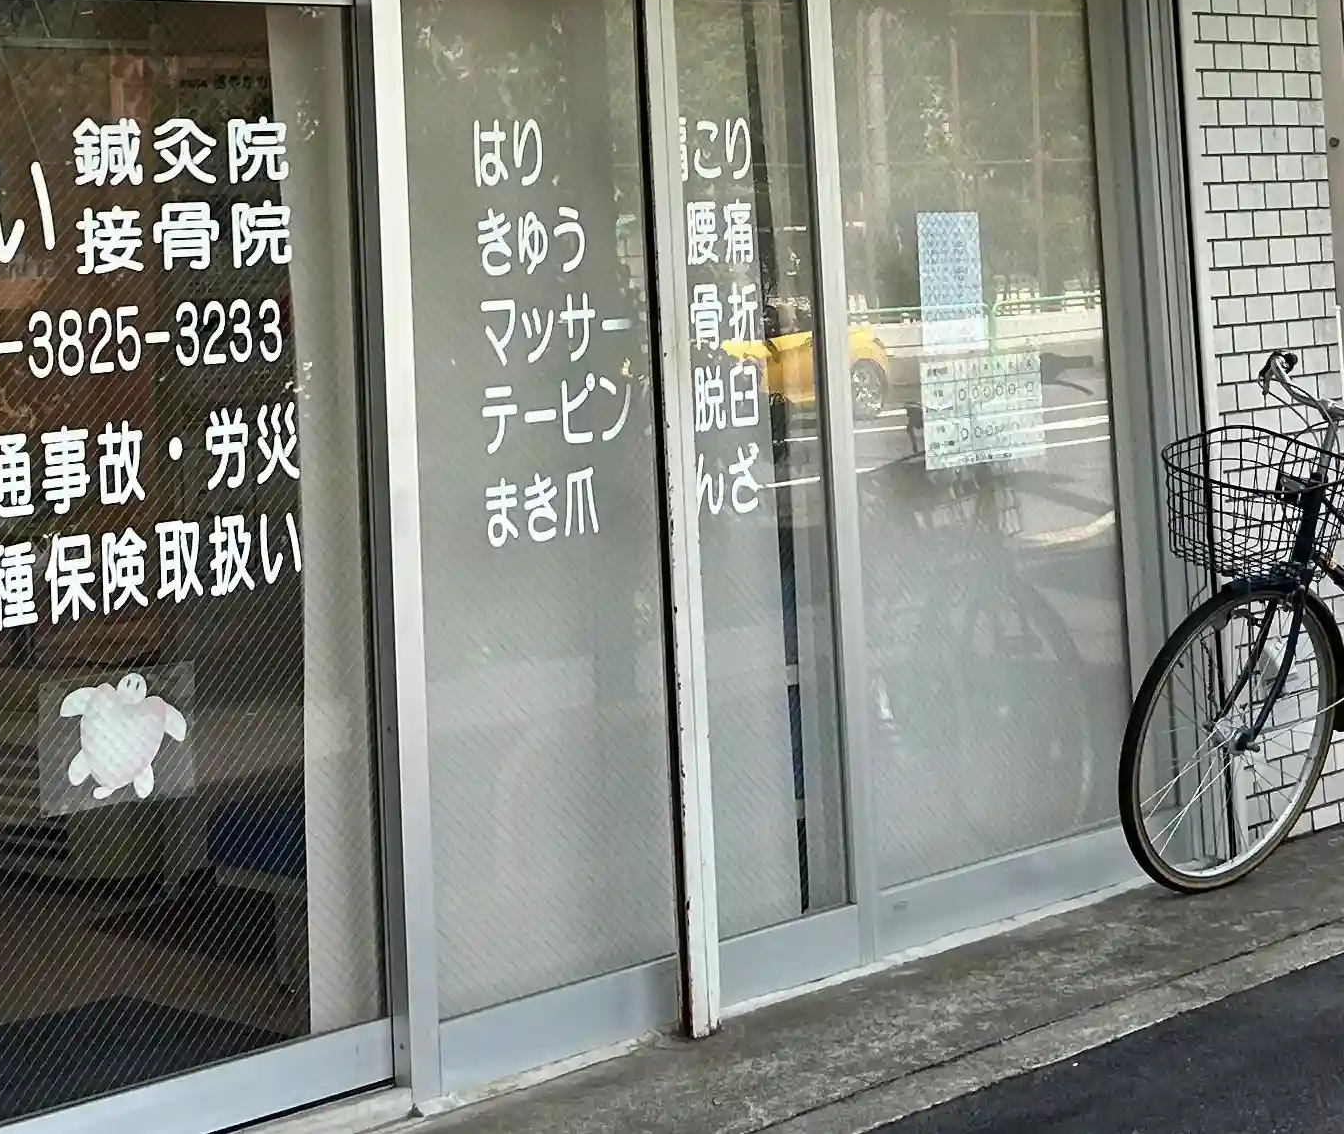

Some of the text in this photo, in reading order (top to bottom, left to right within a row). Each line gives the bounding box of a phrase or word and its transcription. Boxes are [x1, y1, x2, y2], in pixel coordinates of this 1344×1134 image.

[73, 117, 289, 187] 鍼灸院
[473, 118, 543, 187] はり
[76, 200, 293, 275] 接骨院
[477, 206, 586, 276] きゅう
[686, 198, 754, 266] 腰痛
[690, 282, 758, 351] 骨折
[694, 364, 760, 433] 脱臼
[485, 467, 600, 548] まき爪
